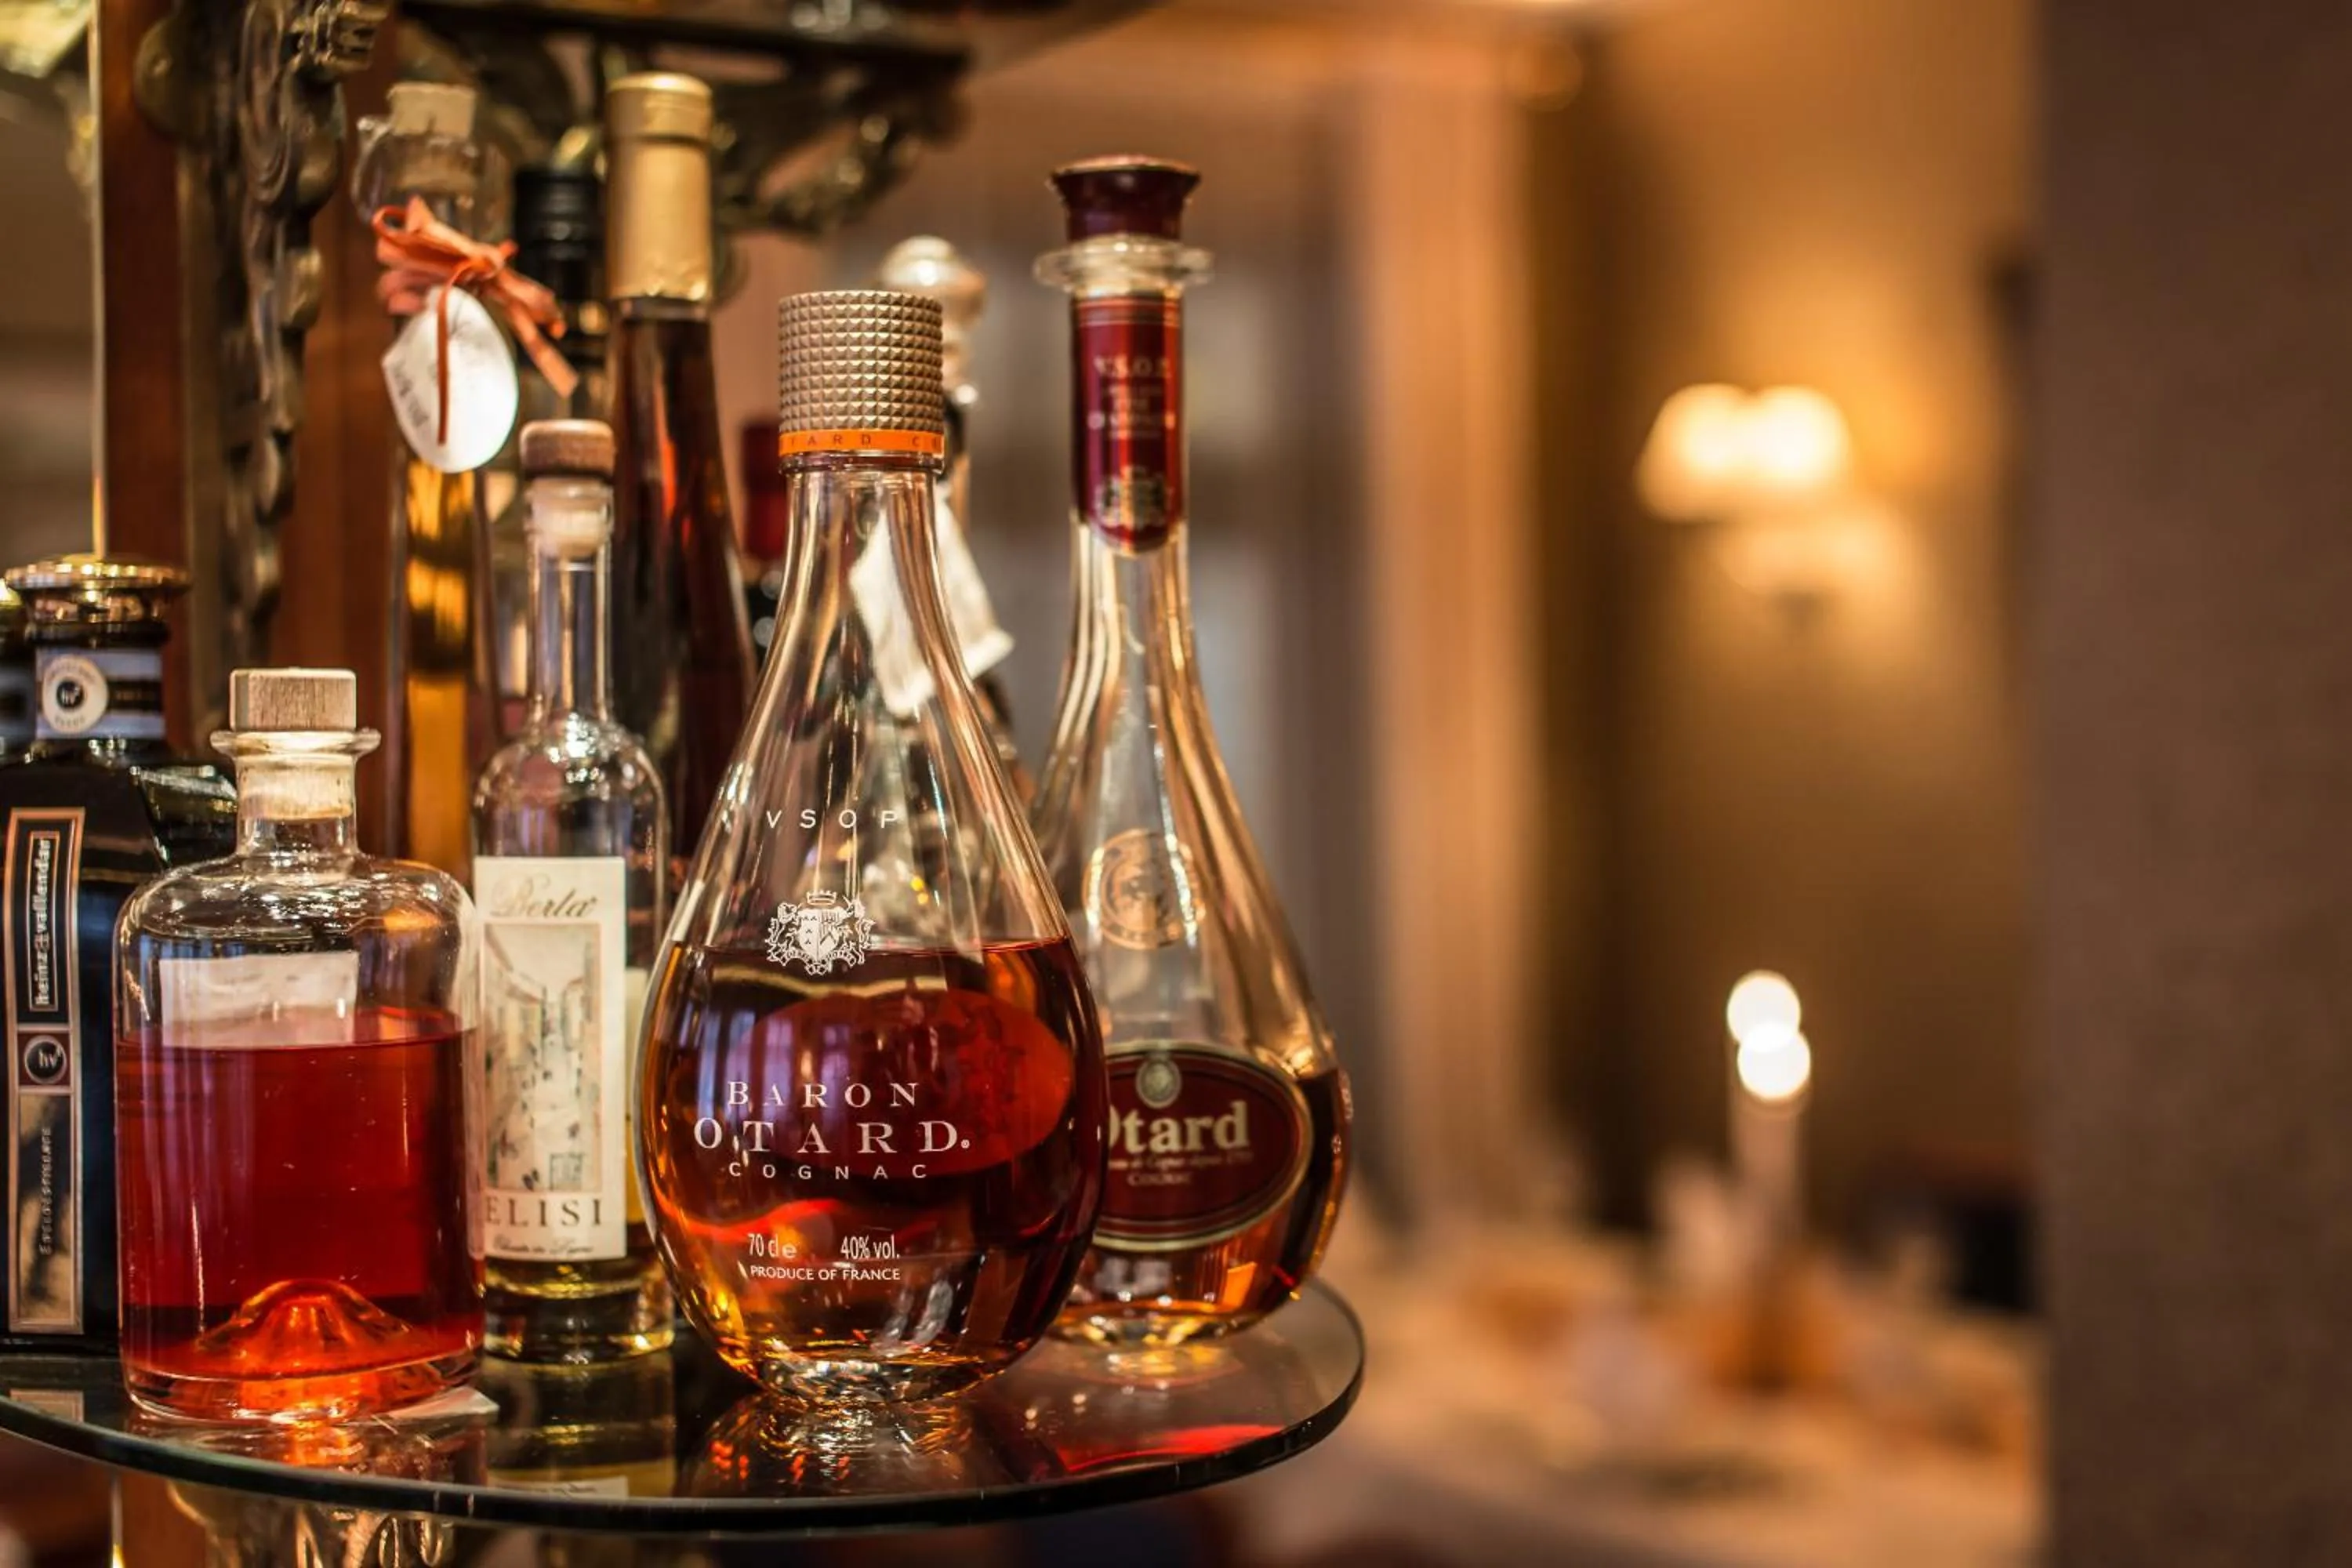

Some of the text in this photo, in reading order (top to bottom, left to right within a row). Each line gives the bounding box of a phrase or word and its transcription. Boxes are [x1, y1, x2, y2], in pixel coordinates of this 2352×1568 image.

[766, 809, 898, 829] VSOP
[728, 1081, 920, 1108] BARON
[728, 1162, 927, 1181] COGNAC
[484, 1196, 602, 1227] ELISI
[748, 1233, 764, 1257] 70
[840, 1236, 870, 1261] 40%
[873, 1234, 901, 1260] vol.
[750, 1265, 902, 1281] PRODUCE OF FRANCE
